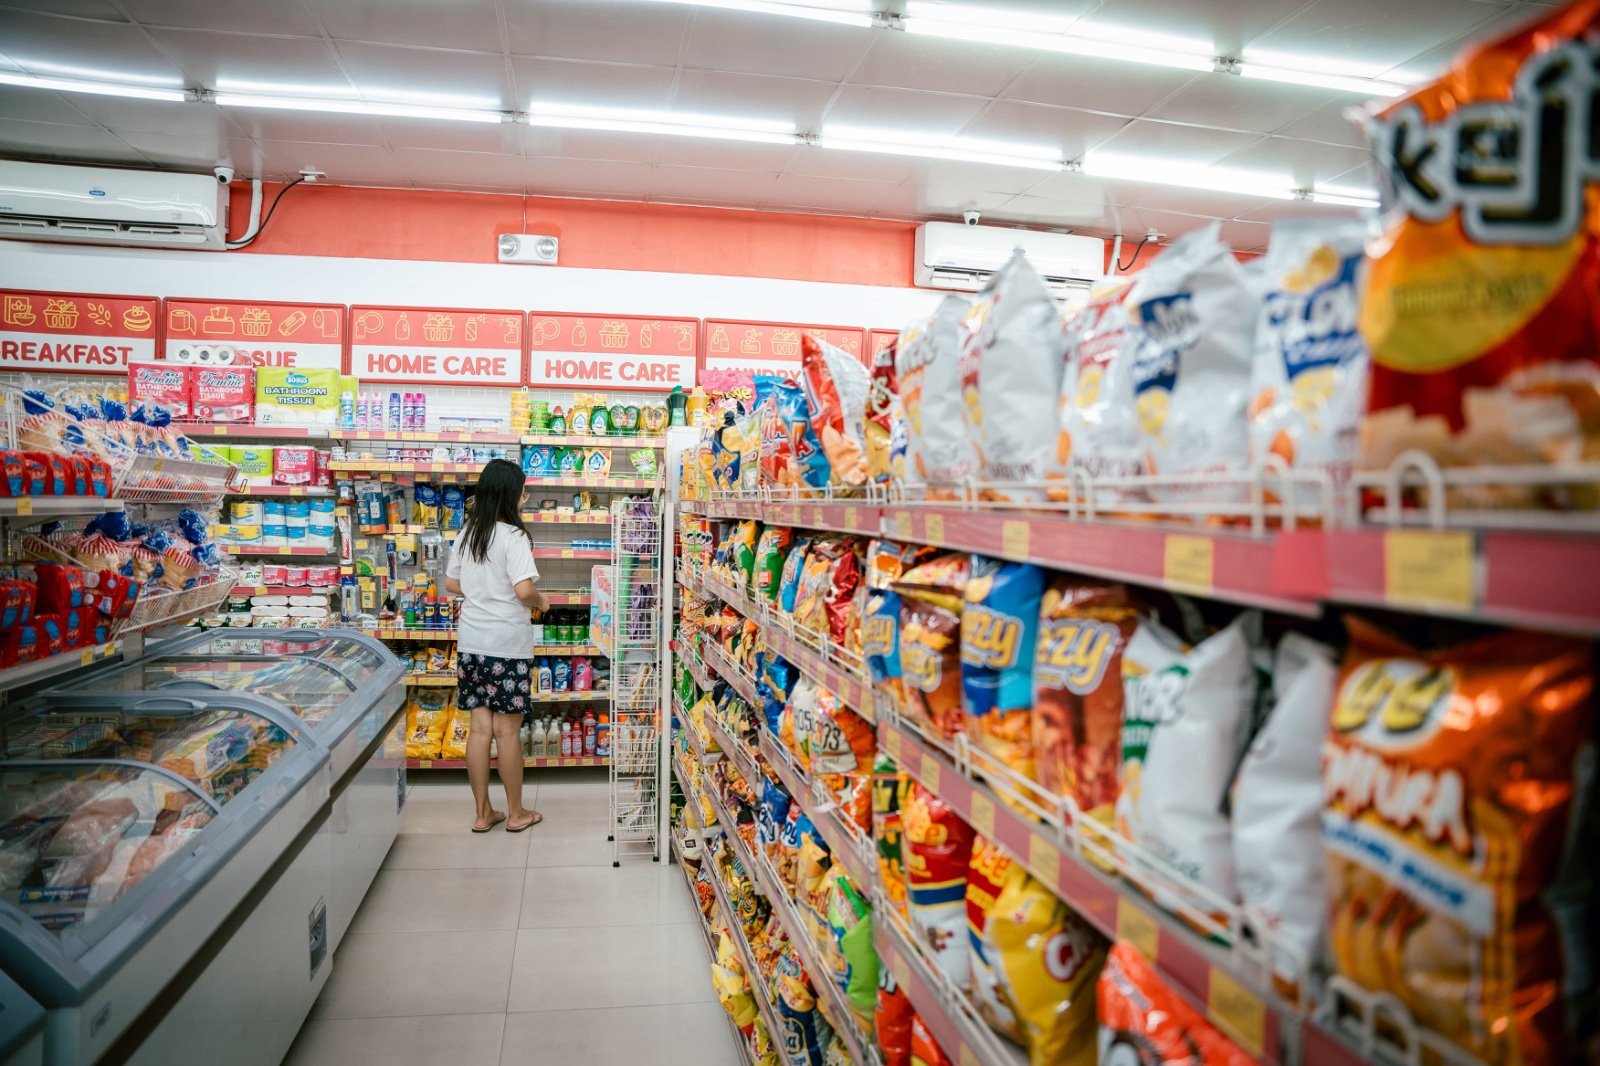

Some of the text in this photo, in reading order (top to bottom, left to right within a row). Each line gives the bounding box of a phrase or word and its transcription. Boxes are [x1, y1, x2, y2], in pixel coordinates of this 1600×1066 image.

[0, 340, 133, 366] REAKFAST
[251, 350, 297, 368] SUE
[367, 353, 507, 376] HOME CARE
[544, 358, 681, 382] HOME CARE
[136, 383, 182, 392] BATHROOM
[199, 386, 244, 394] BATHROOM
[264, 387, 327, 396] BATHROOM
[136, 389, 164, 397] TISSUE
[276, 397, 315, 405] TISSUE
